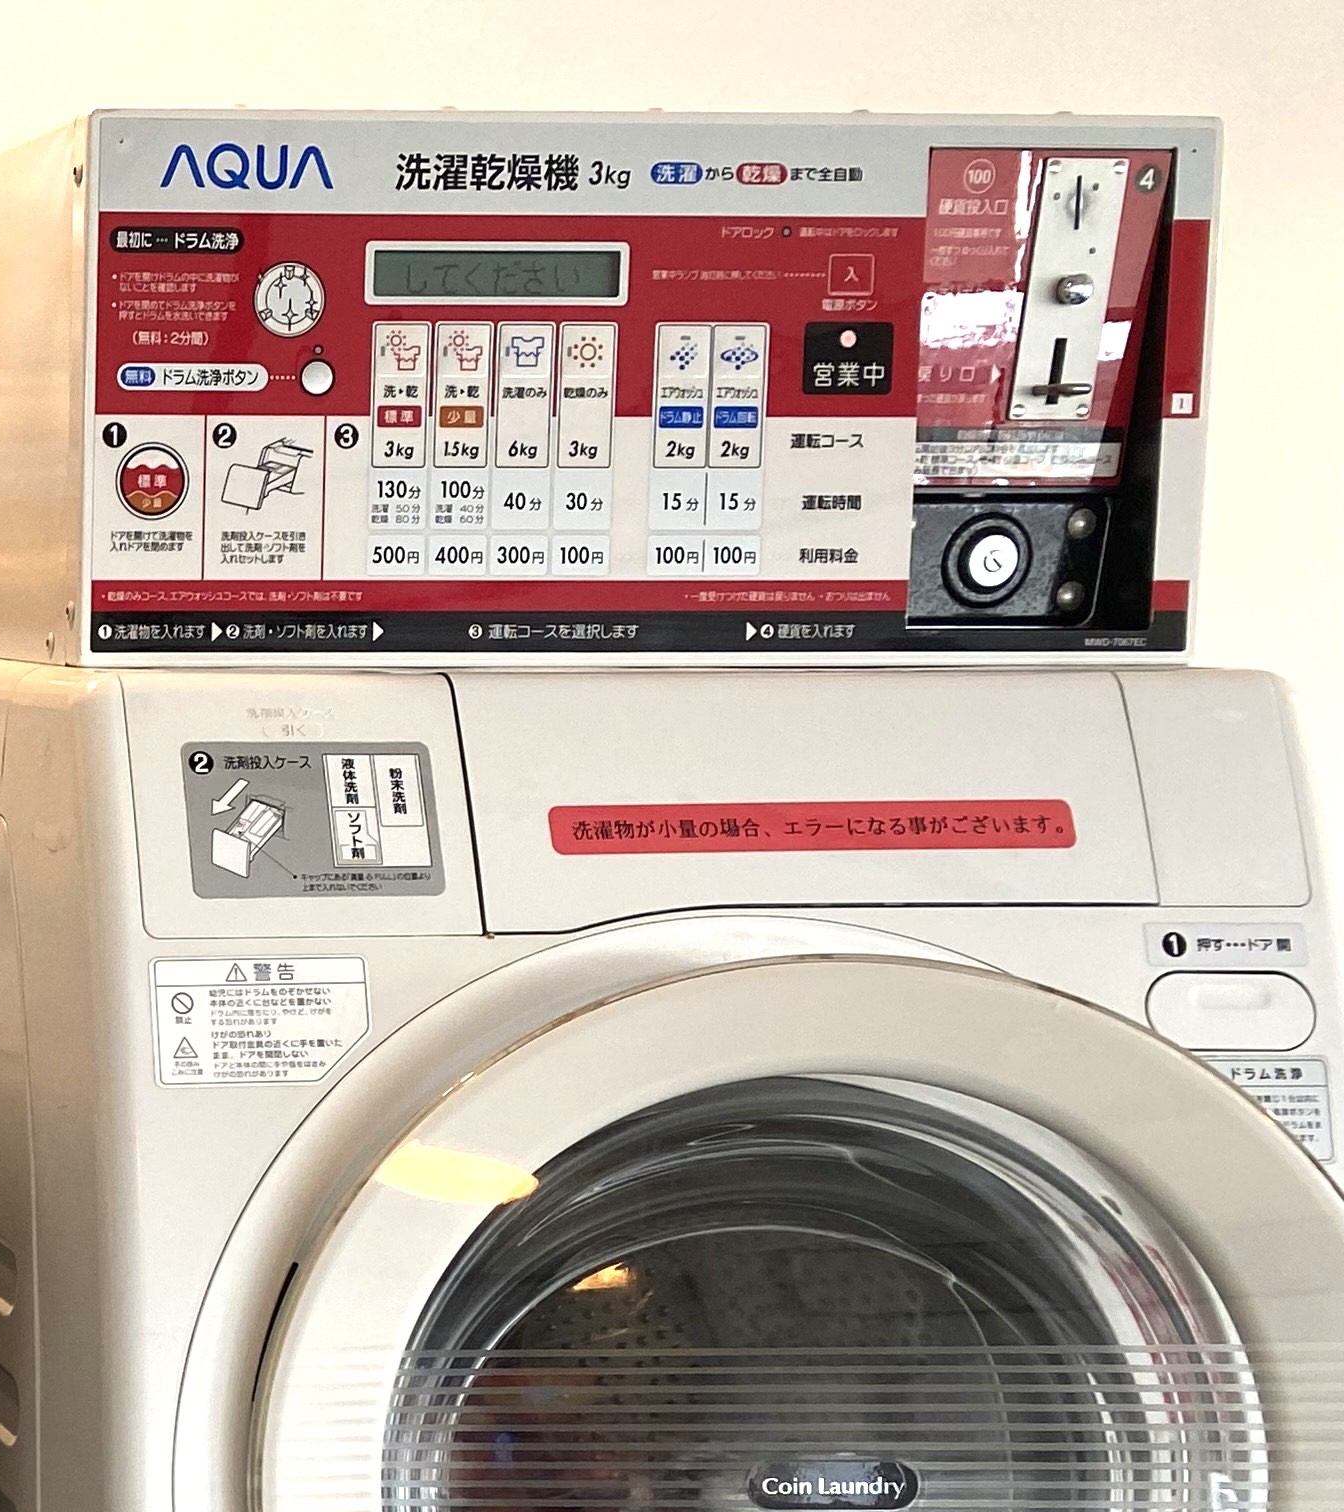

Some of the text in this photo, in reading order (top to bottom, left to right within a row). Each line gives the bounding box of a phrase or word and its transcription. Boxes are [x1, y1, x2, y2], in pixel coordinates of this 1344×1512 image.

[160, 143, 334, 190] AQUA
[395, 152, 631, 192] 洗濯乾燥機 3kg
[720, 226, 774, 240] ドアロック
[406, 261, 580, 294] してください
[821, 299, 878, 312] 電源ボタン
[125, 369, 259, 386] 無料 ドラム洗浄ボタン
[812, 363, 886, 387] 営業中
[502, 387, 547, 399] 洗濯のみ
[564, 387, 608, 399] 乾燥のみ
[385, 410, 414, 424] 標準
[447, 410, 477, 424] 少量
[661, 411, 702, 424] ドラム静止
[715, 411, 757, 424] ドラム回転
[384, 441, 413, 459] 3kg
[508, 441, 538, 459] 6kg
[666, 441, 695, 459] 2kg
[721, 441, 749, 459] 2kg
[791, 433, 864, 449] 運転コース
[569, 441, 598, 460] 3kg
[138, 474, 167, 488] 標準
[377, 481, 421, 499] 130分
[441, 481, 485, 499] 100分
[802, 495, 861, 510] 運転時間
[372, 547, 420, 564] 500円
[435, 547, 483, 565] 400円
[497, 547, 545, 565] 300円
[560, 547, 604, 565] 100円
[655, 547, 699, 564] 100円
[713, 547, 756, 564] 100円
[799, 548, 859, 563] 利用料金
[224, 756, 311, 769] 洗剤投入ケース
[341, 758, 359, 805] 液体洗剤
[389, 768, 407, 814] 粉末洗剤
[347, 812, 365, 859] ソフト剤
[572, 815, 1066, 840] 洗濯物が小量の場合、エラーになる事がございます。
[253, 963, 295, 981] 警告
[1231, 1067, 1303, 1080] ドラム洗浄
[762, 1477, 905, 1499] Coin Laundry
